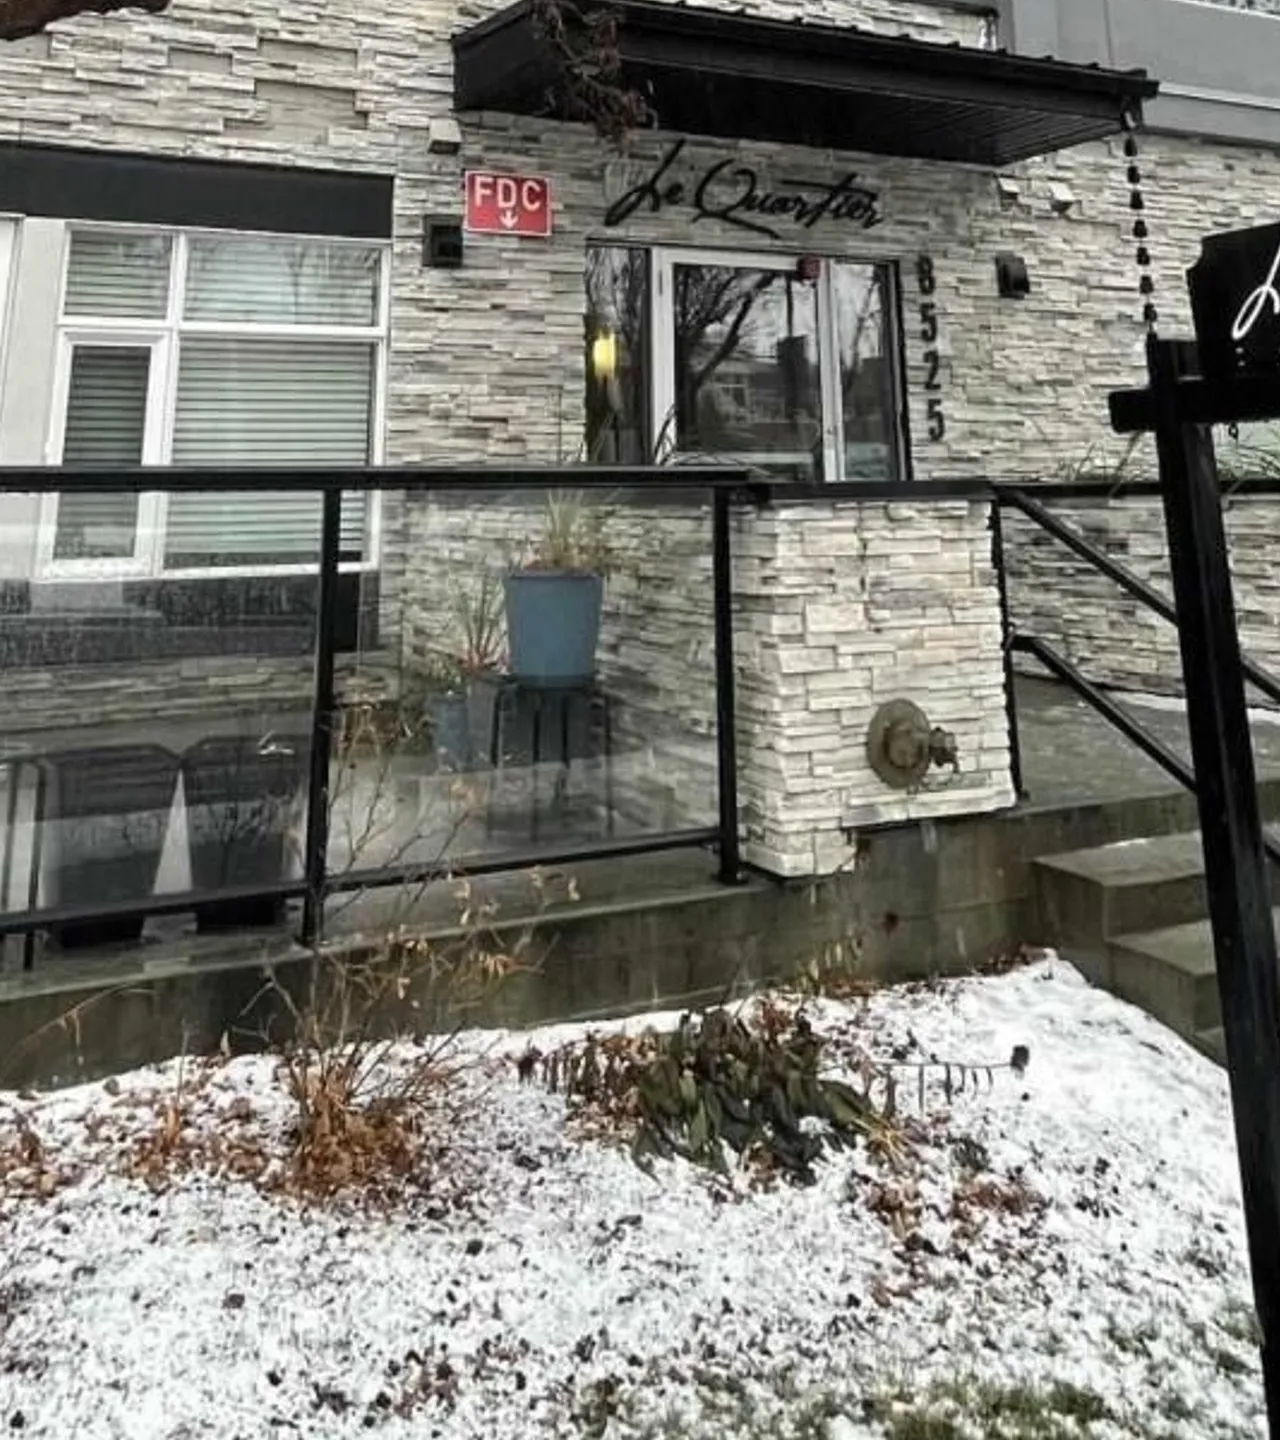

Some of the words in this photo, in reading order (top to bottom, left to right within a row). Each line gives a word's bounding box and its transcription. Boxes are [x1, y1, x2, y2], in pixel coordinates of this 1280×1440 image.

[474, 175, 542, 212] FDC
[604, 138, 686, 227] Le
[689, 158, 884, 240] Quartier
[917, 253, 945, 442] 8525
